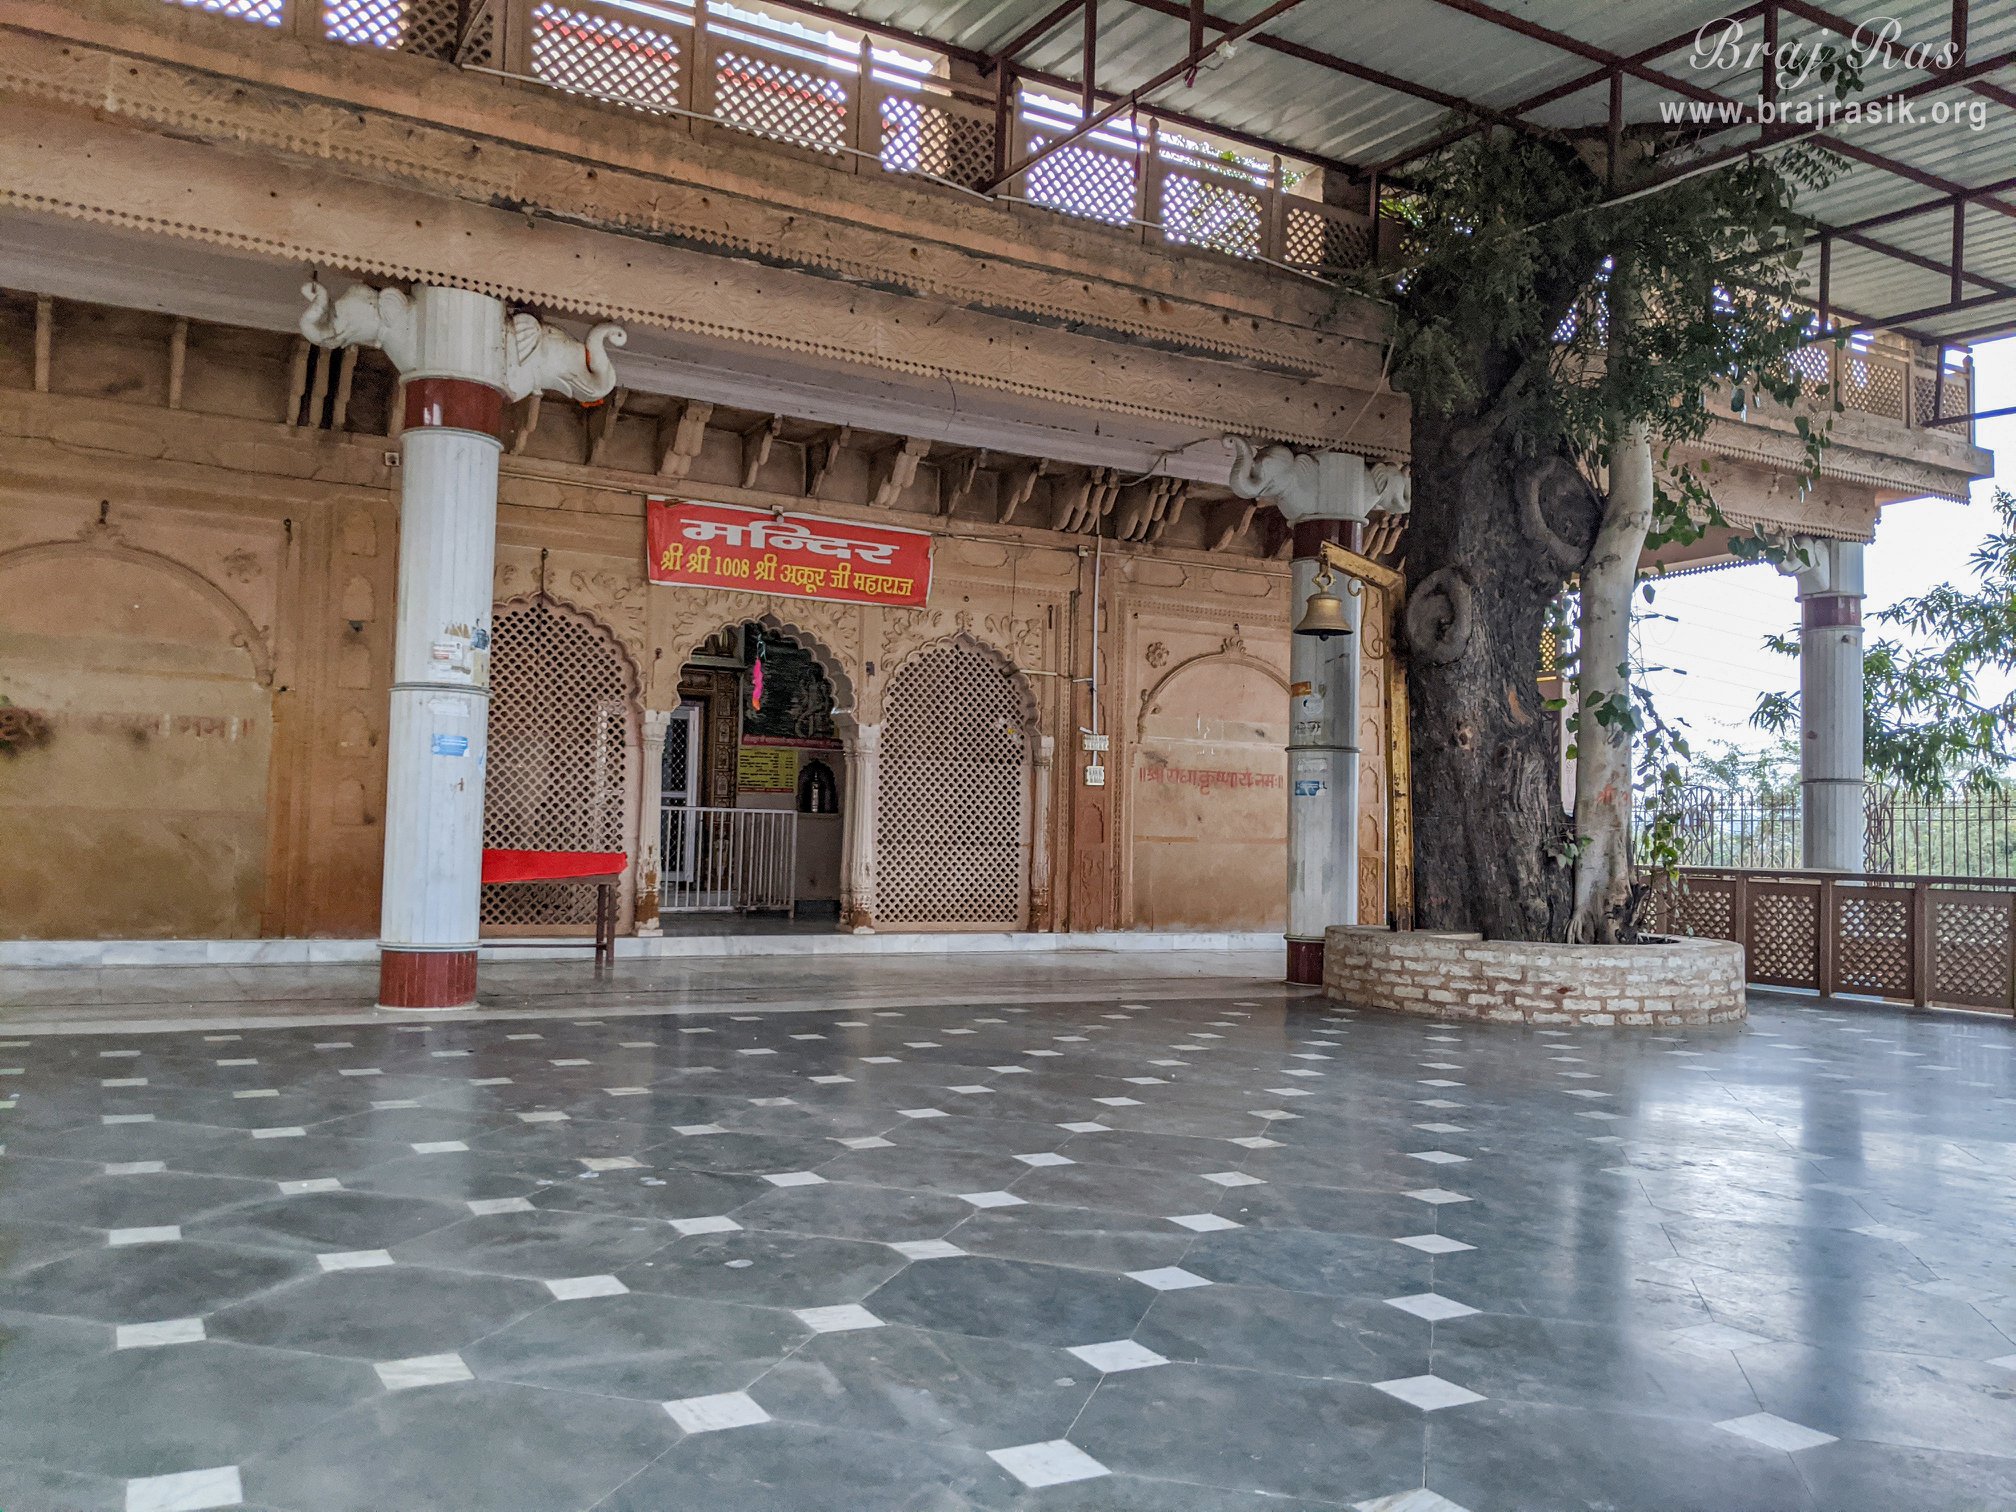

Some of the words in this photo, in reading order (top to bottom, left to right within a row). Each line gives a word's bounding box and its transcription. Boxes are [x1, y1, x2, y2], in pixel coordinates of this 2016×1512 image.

[680, 519, 900, 564] मन्दिर
[660, 543, 683, 571] श्री
[686, 545, 711, 574] श्री
[714, 556, 750, 578] 1008
[754, 553, 778, 581] श्री
[780, 564, 827, 593] अक्रूर
[829, 562, 852, 589] जी
[854, 572, 914, 596] महाराज
